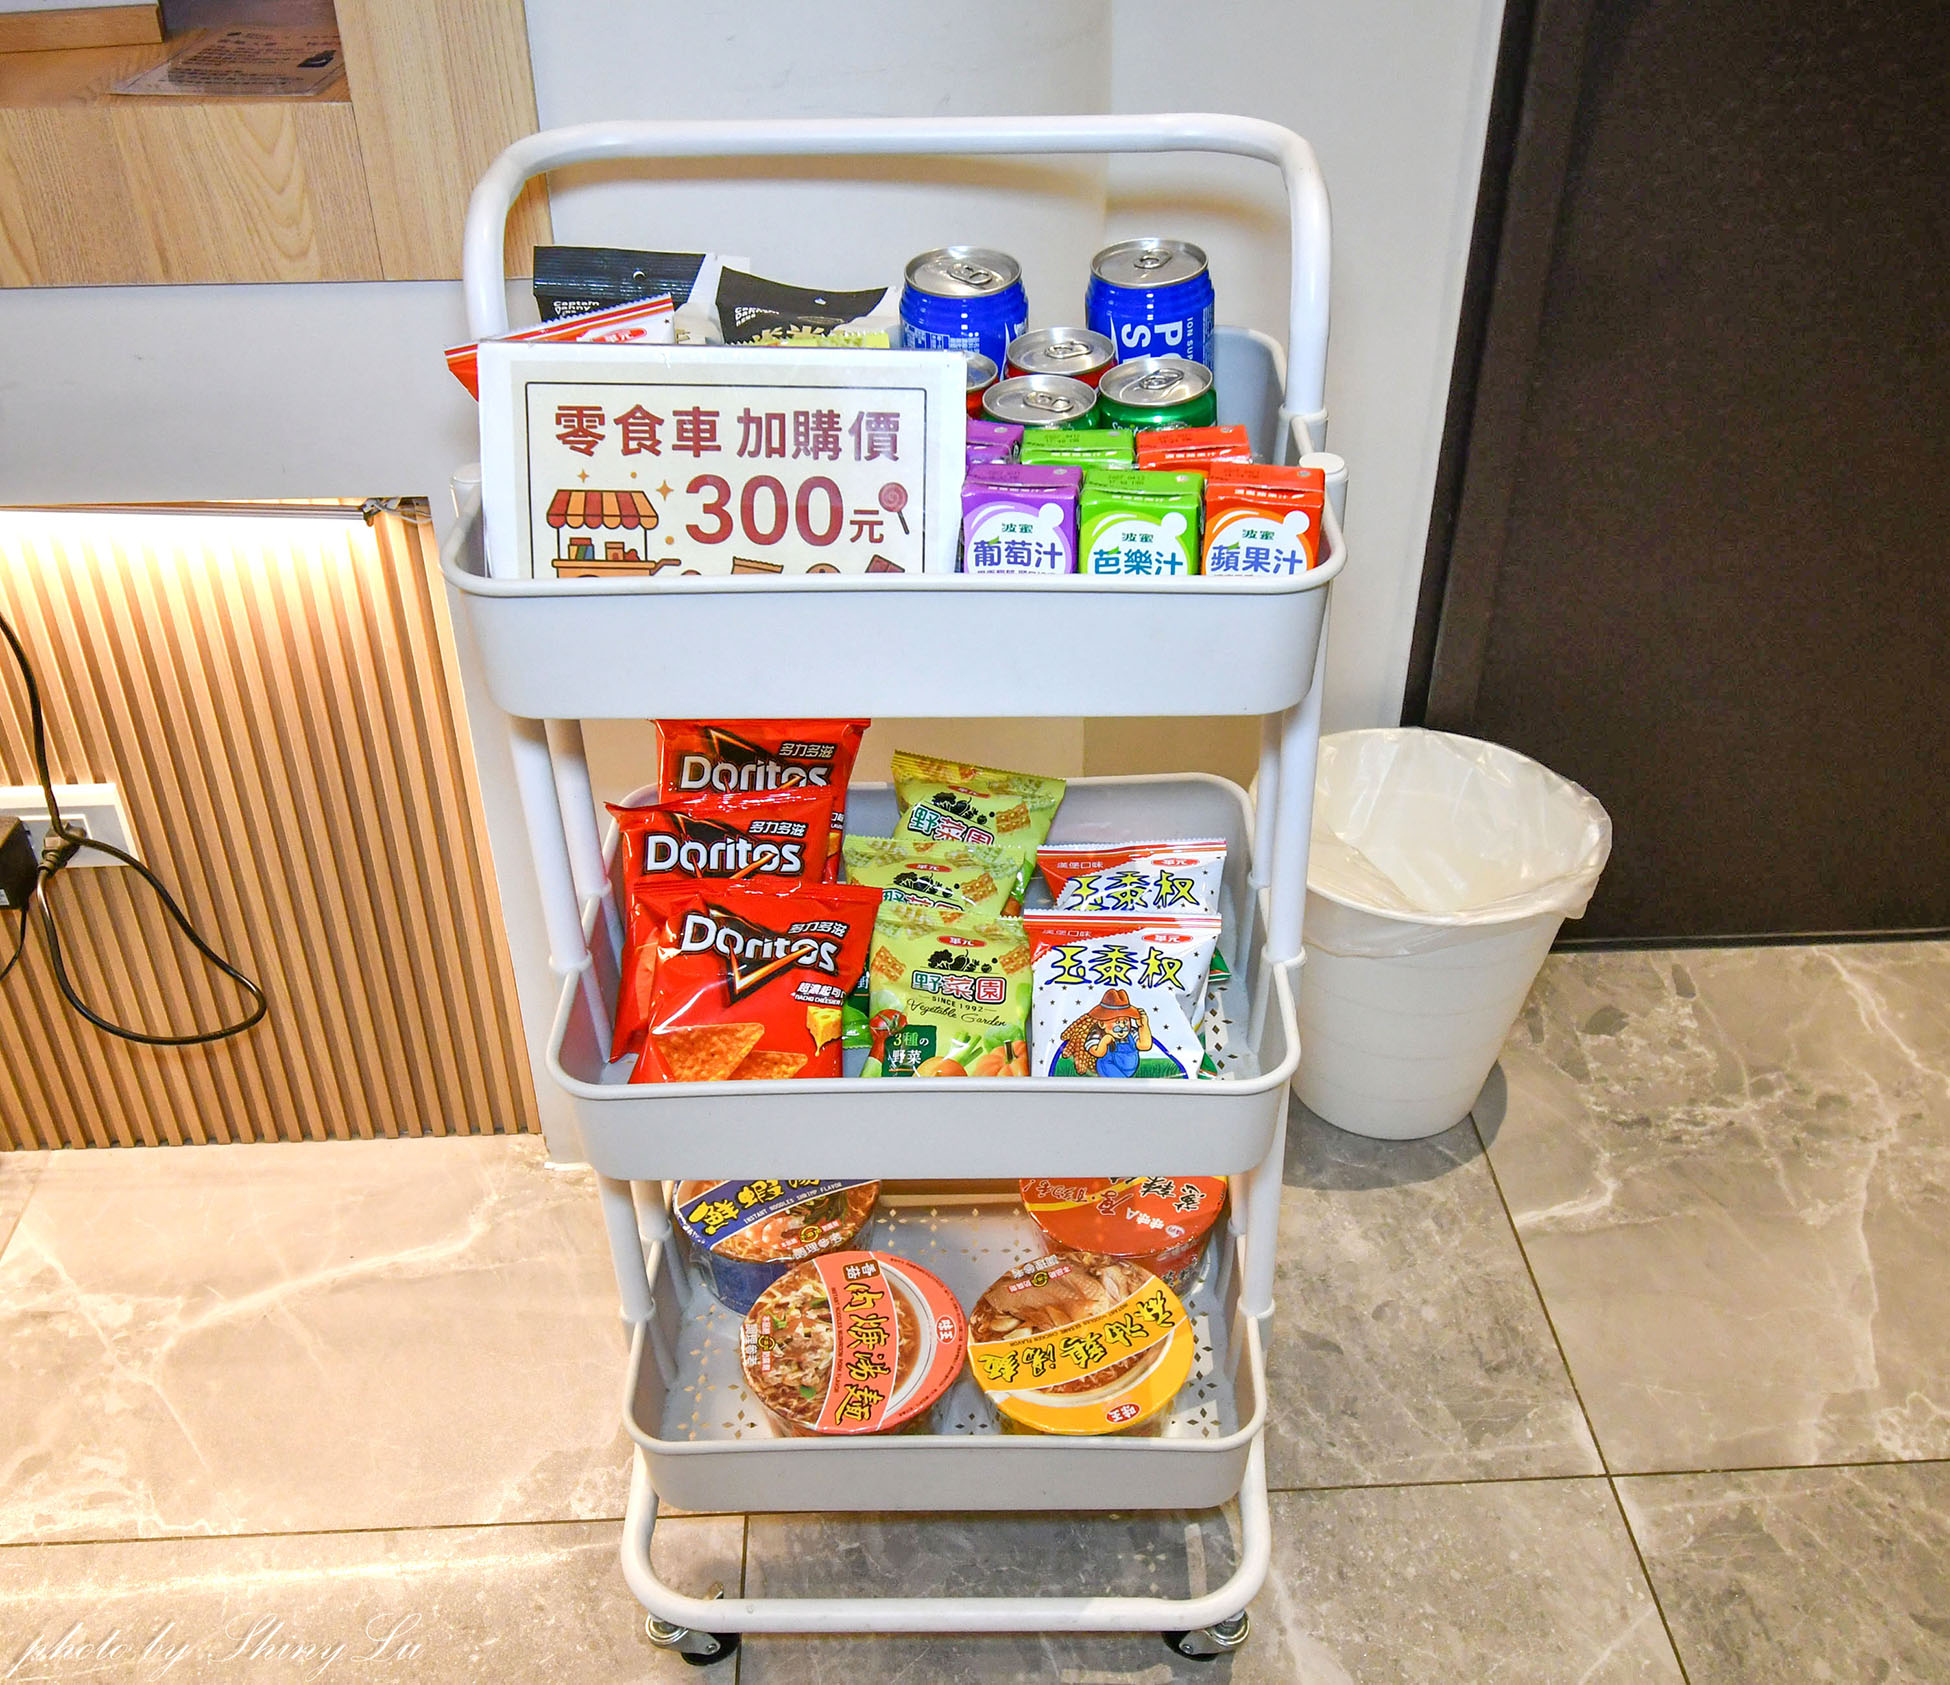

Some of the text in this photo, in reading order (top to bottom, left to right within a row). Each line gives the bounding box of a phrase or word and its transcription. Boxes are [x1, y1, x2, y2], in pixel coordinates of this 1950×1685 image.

[1186, 317, 1194, 360] ION SUP
[554, 404, 901, 462] 零食車 加購價
[685, 474, 885, 547] 300元
[973, 539, 1063, 569] 葡萄汁
[1093, 548, 1184, 576] 芭樂汁
[1210, 544, 1303, 575] 蘋果汁
[779, 743, 835, 759] 多力多滋
[679, 755, 831, 793] Doritos
[749, 820, 806, 837] 多力多滋
[646, 834, 802, 874] Doritos
[680, 914, 838, 973] Doritos
[788, 921, 848, 938] 多力多滋
[912, 970, 1007, 1005] 野菜園
[907, 998, 1007, 1027] Vegetable Garden
[932, 996, 984, 1013] SINCE 1992
[744, 1209, 768, 1225] INSTANT
[769, 1198, 794, 1212] NOODLES
[820, 1181, 843, 1194] FLAVOR
[845, 1262, 877, 1280] 香菇
